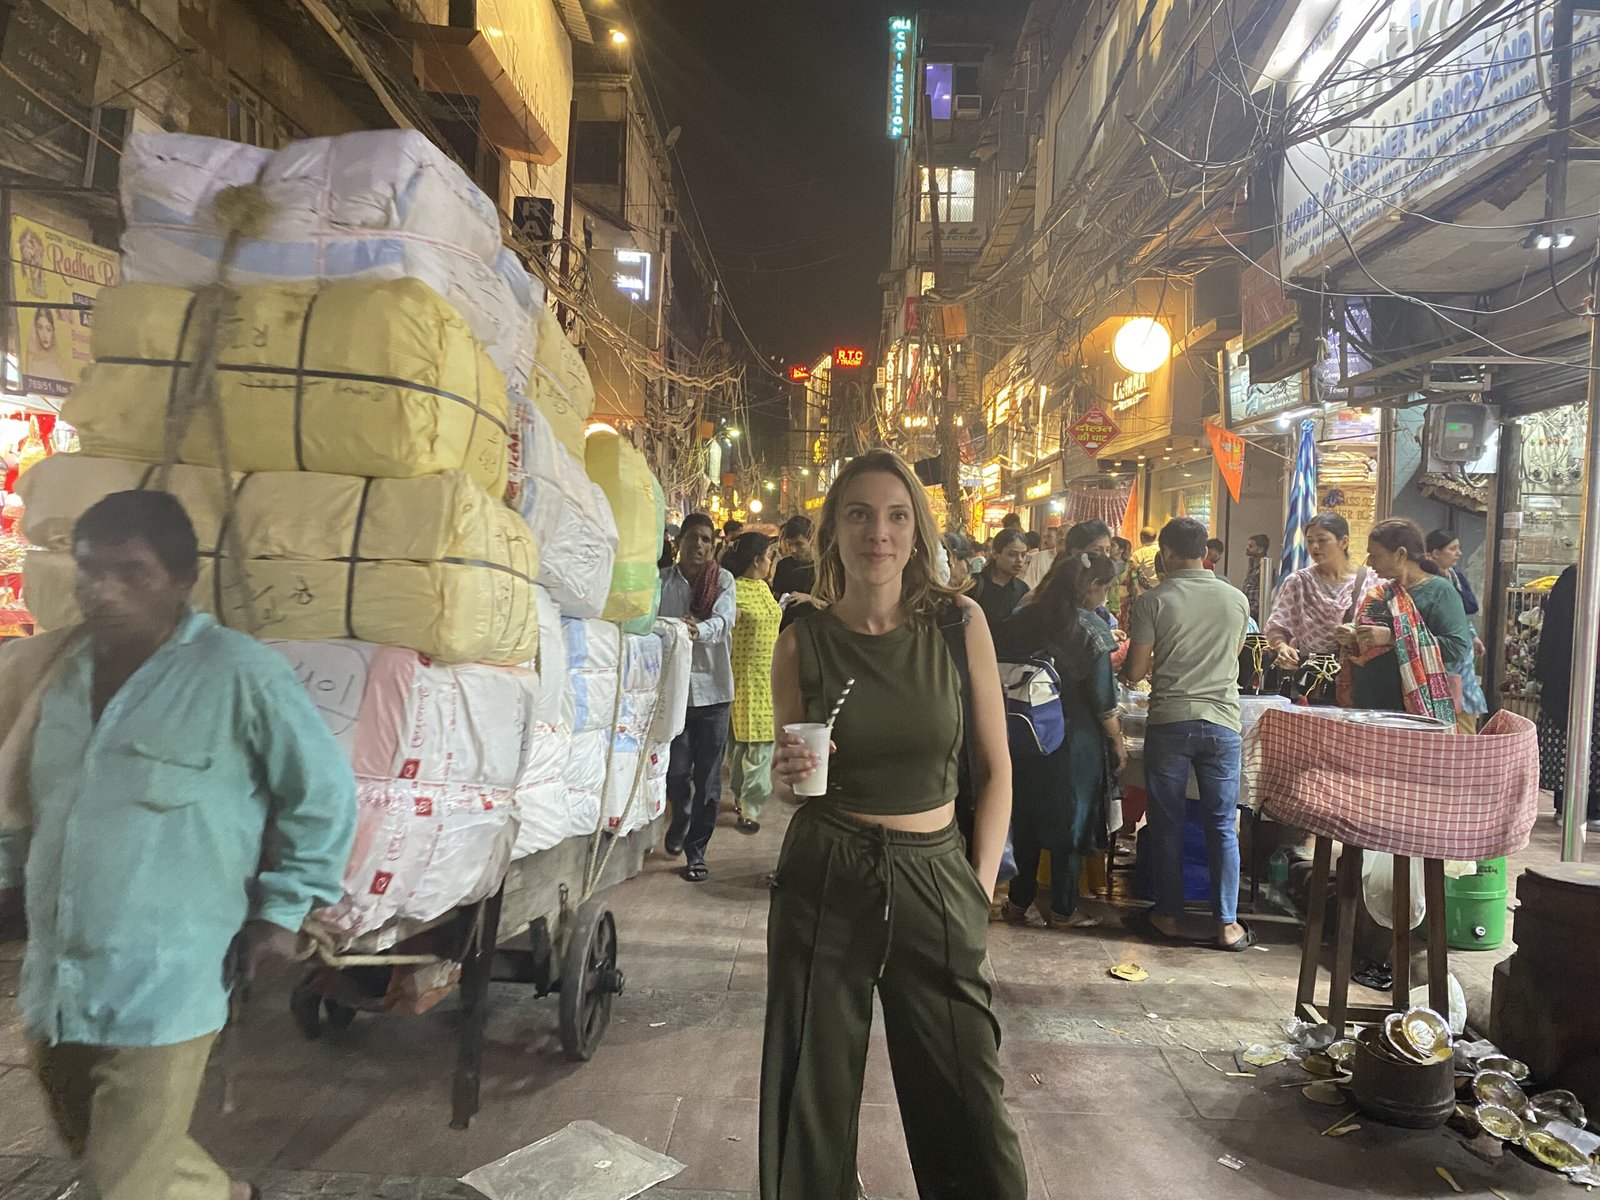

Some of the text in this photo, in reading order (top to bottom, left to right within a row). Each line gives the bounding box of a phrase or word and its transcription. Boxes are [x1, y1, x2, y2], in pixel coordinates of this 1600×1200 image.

[1285, 192, 1319, 240] HOUSE
[1342, 127, 1408, 197] DESIGNER
[1412, 64, 1485, 147] FABRICS
[1488, 30, 1532, 93] AND
